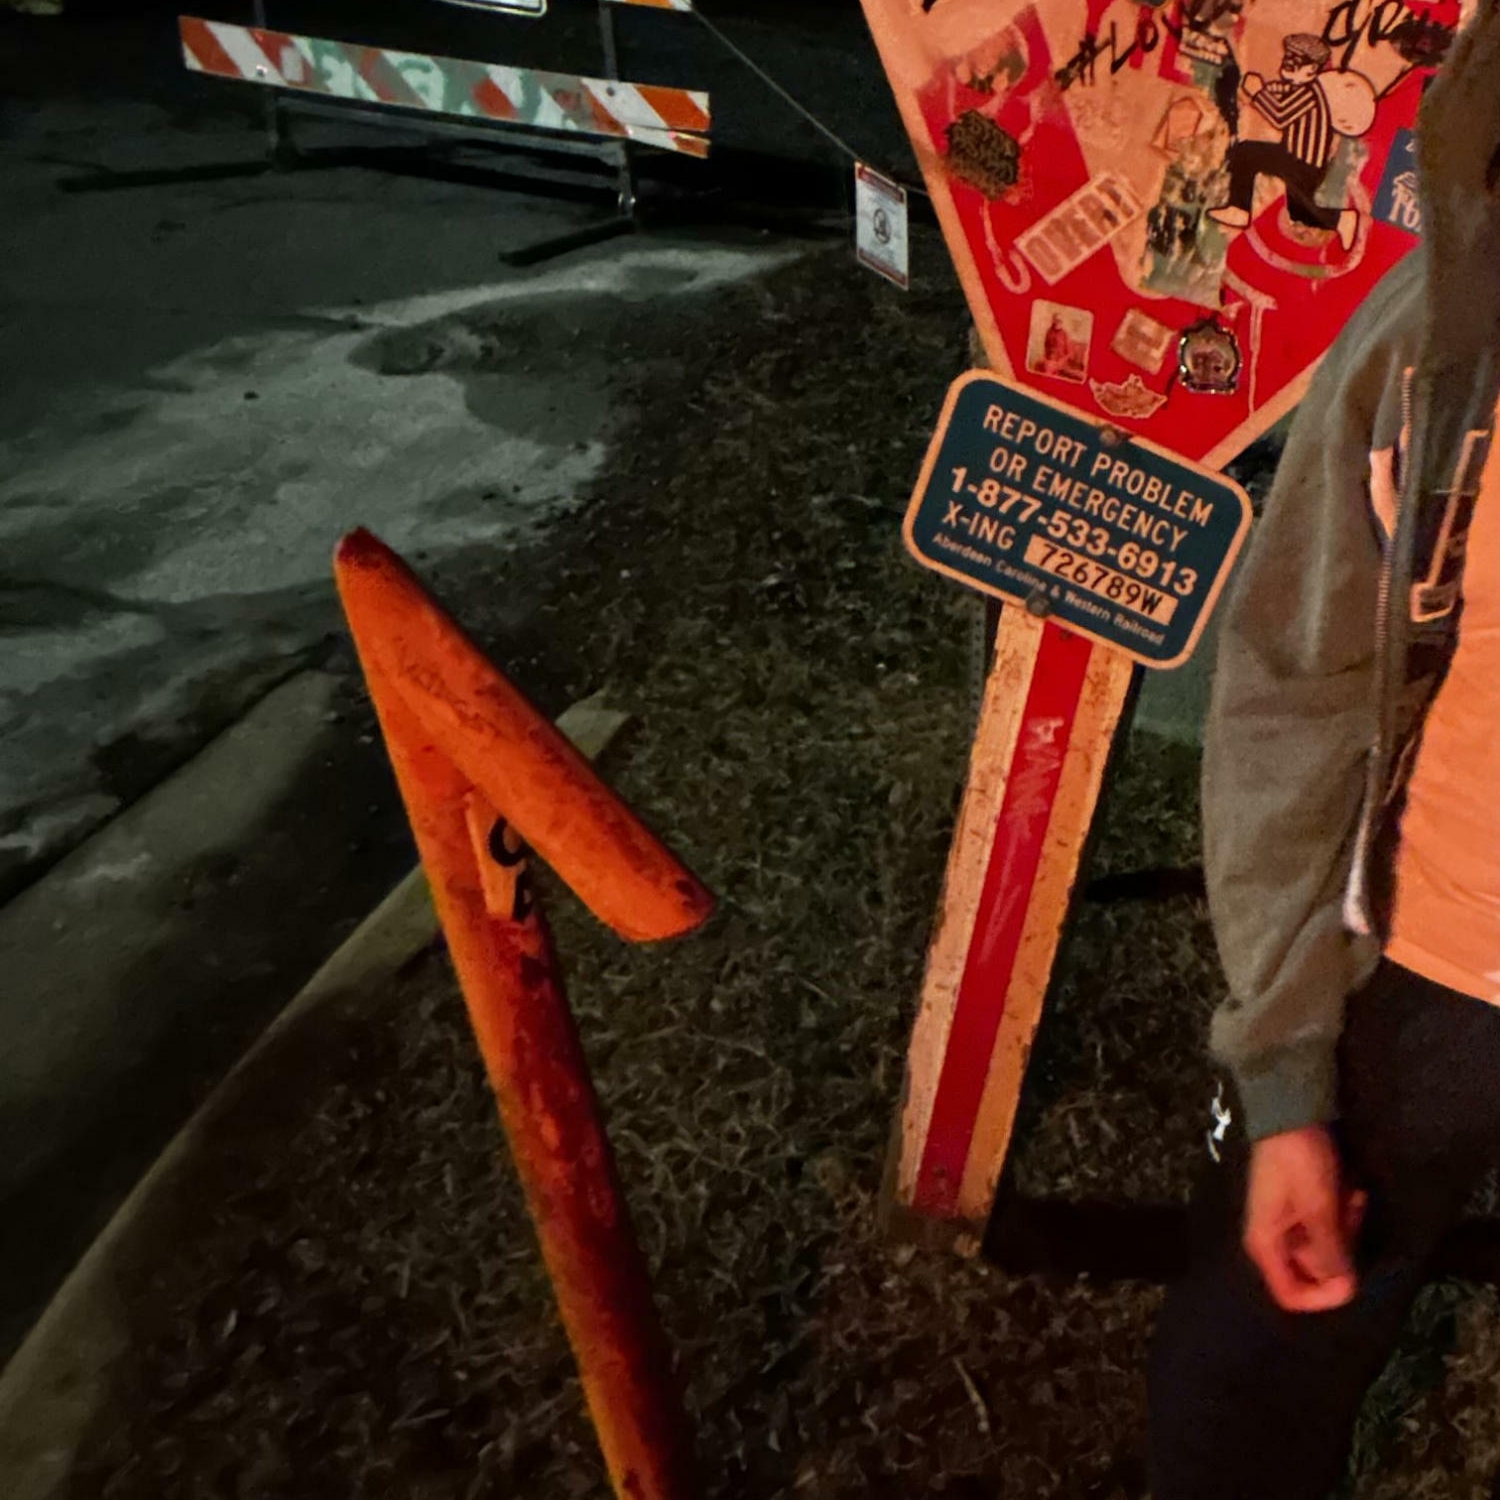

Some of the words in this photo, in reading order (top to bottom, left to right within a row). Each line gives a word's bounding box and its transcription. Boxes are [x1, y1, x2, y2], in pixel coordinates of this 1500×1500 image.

[983, 404, 1087, 468] REPORT
[1090, 452, 1215, 528] PROBLEM
[989, 447, 1027, 482] OR
[1032, 465, 1188, 553] EMERGENCY
[932, 532, 992, 569] Aberdeen
[995, 558, 1047, 593] Carolina
[1064, 588, 1111, 622] Western
[942, 500, 1016, 550] X-ING
[1038, 543, 1163, 617] 726789W
[951, 466, 1198, 597] 1-877-533-6913
